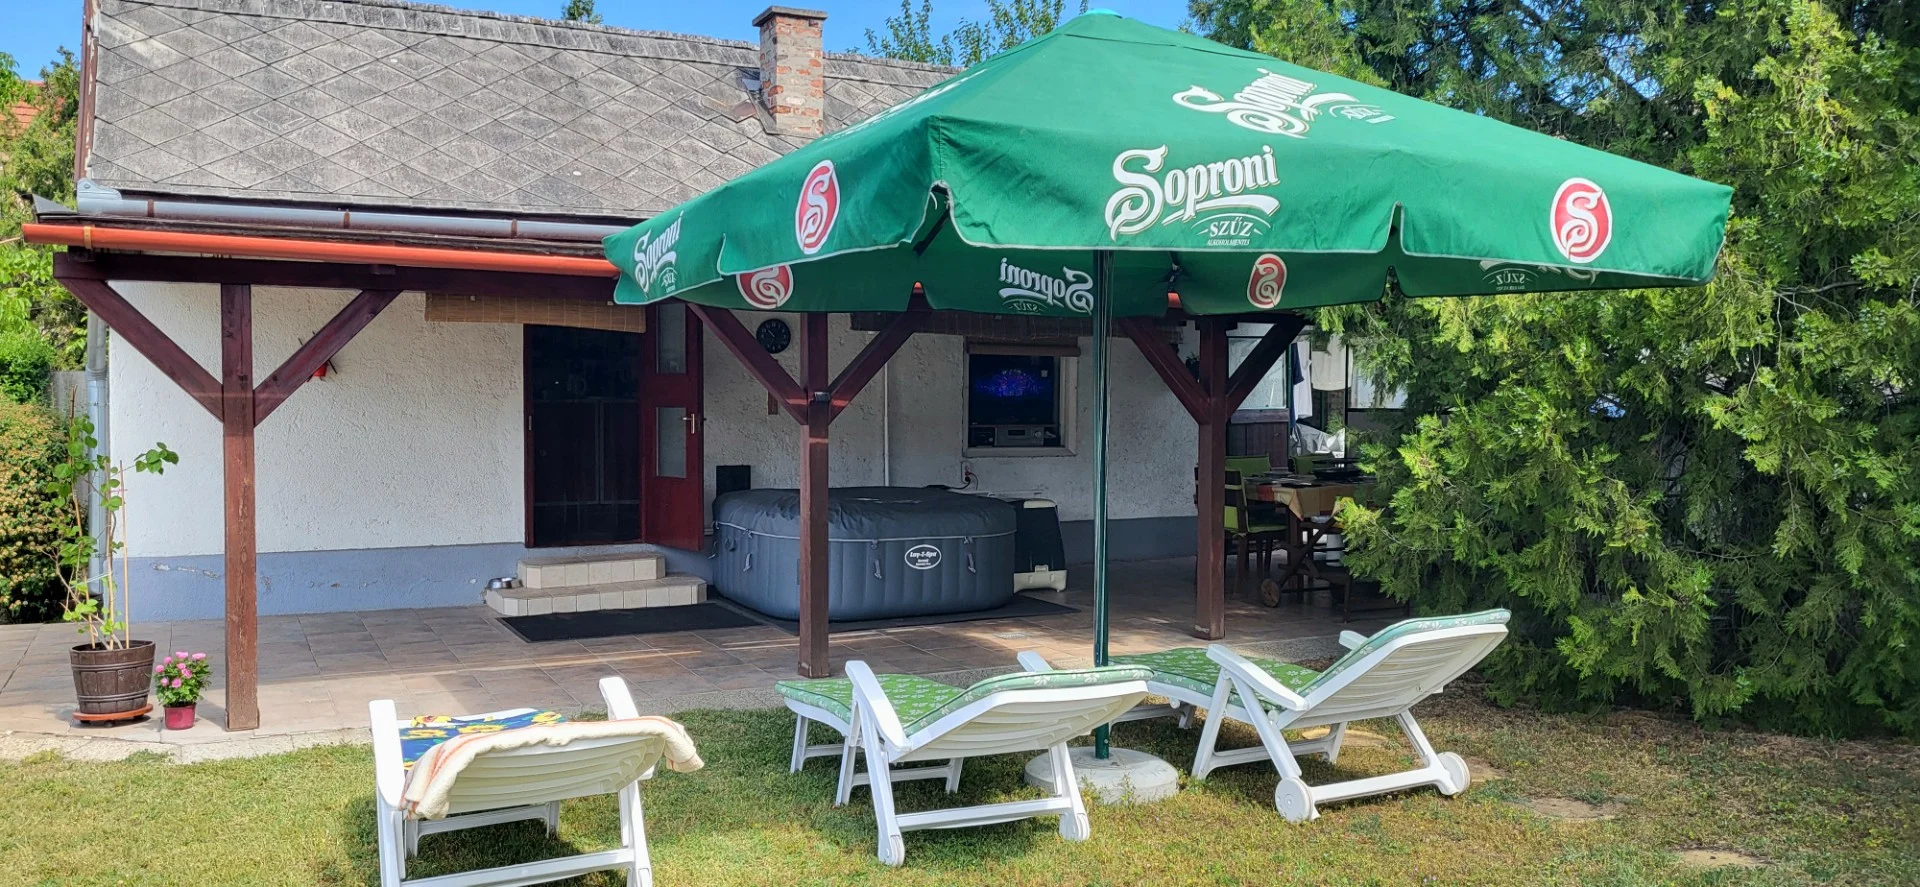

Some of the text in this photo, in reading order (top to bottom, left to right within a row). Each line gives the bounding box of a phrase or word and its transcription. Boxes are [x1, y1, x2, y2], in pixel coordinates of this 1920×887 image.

[1172, 67, 1323, 139] Soproni
[1104, 144, 1281, 242] Soproni
[1560, 188, 1603, 260] S
[633, 210, 685, 297] Soproni
